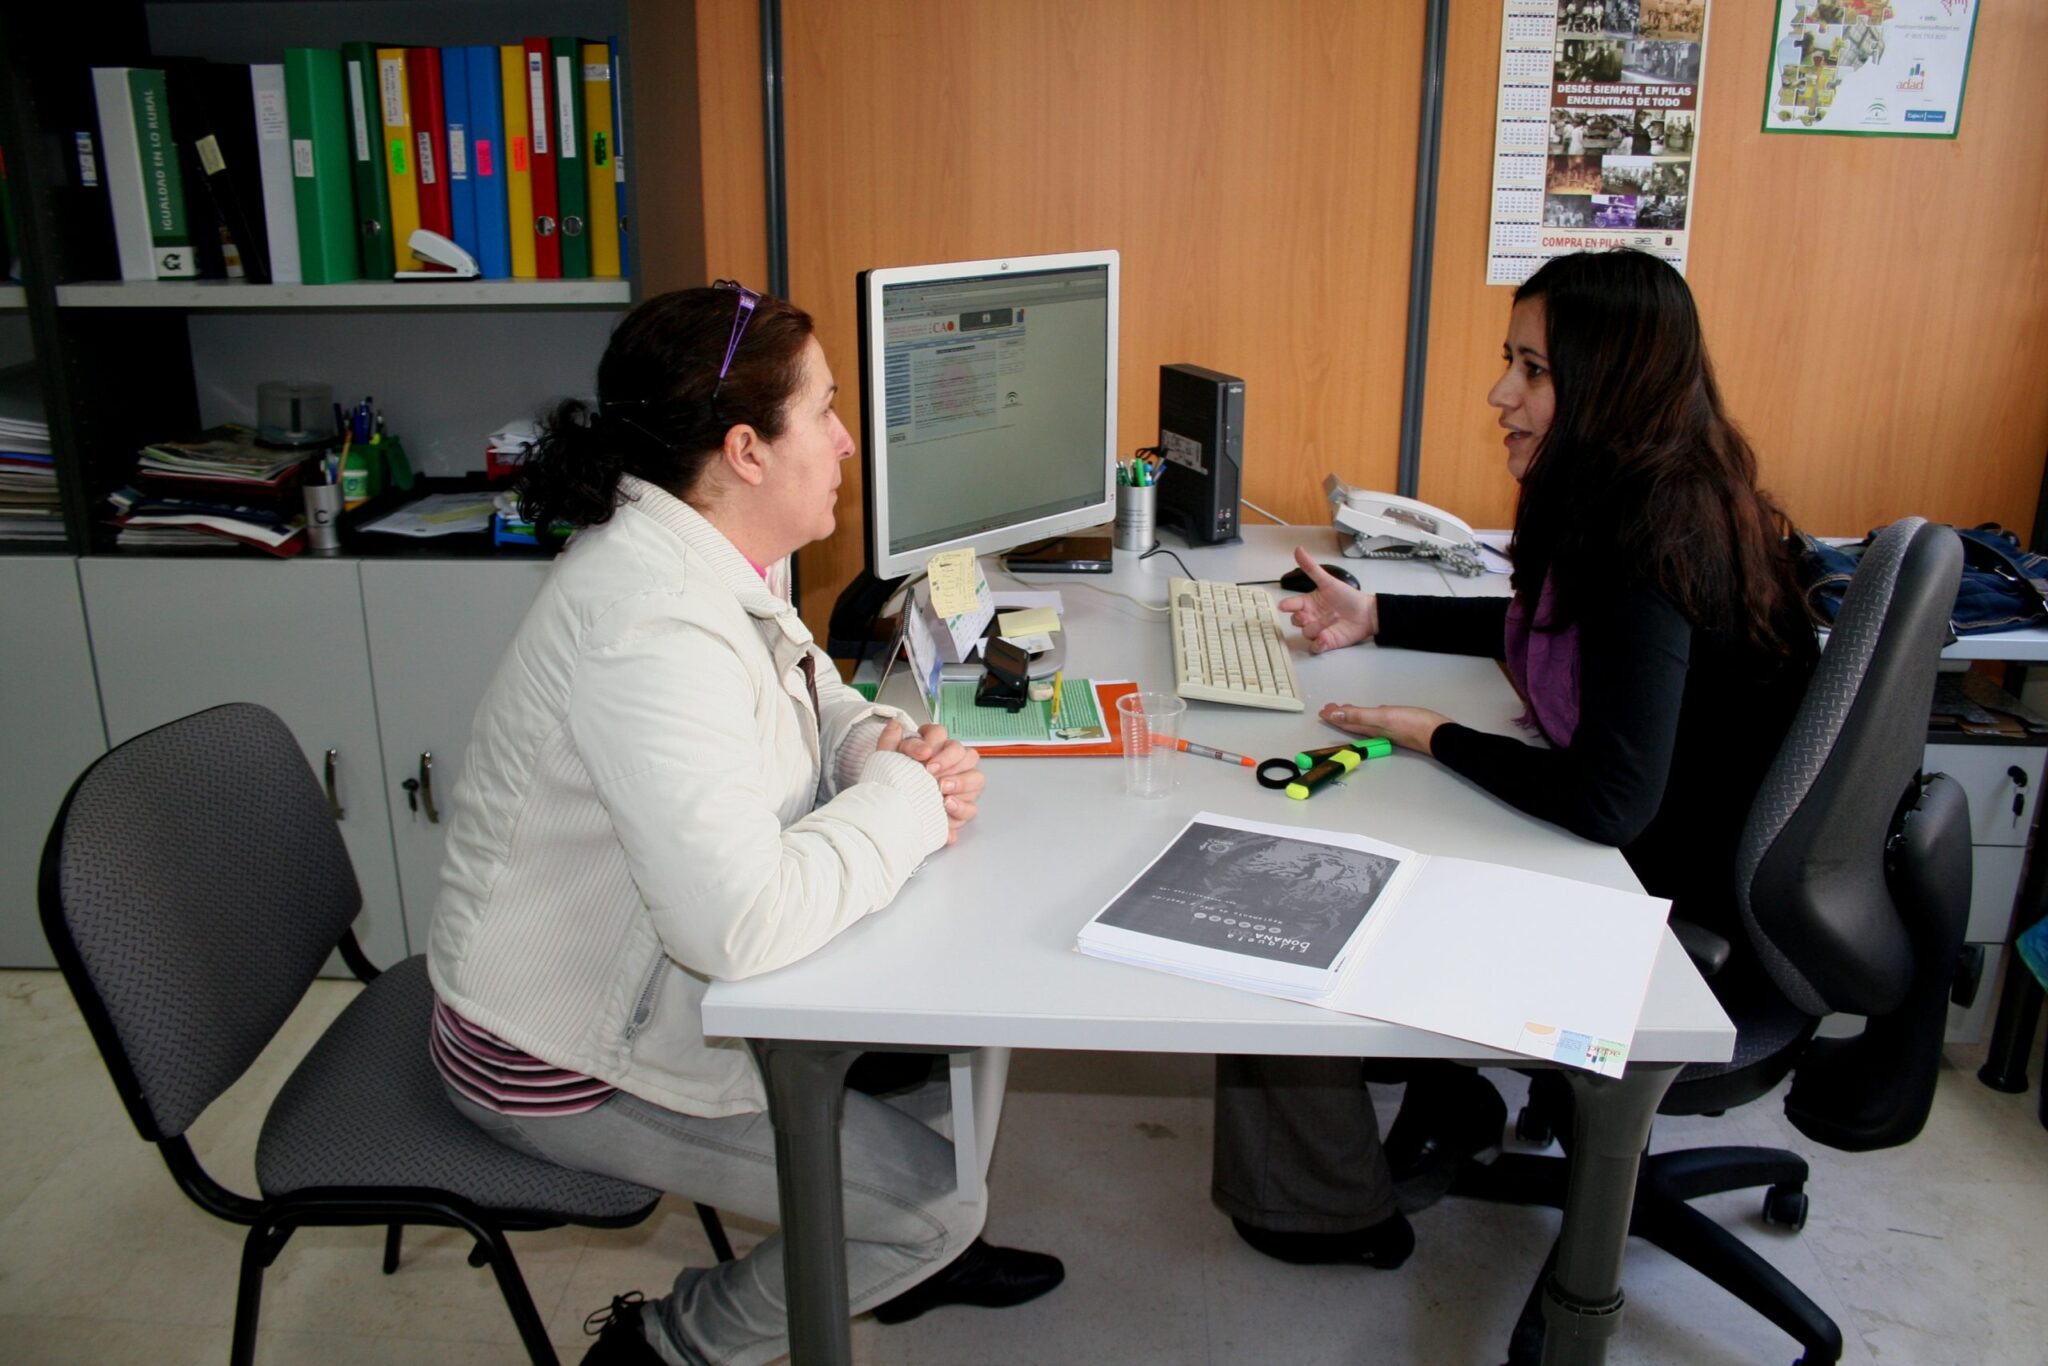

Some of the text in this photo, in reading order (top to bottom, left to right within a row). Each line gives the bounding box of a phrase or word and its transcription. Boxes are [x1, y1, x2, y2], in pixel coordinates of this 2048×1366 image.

[1557, 84, 1692, 96] DESDE SIEMPRE, EN PILAS
[1896, 79, 1924, 89] adad
[1567, 96, 1680, 107] ENCUENTRAS DE TODO
[144, 89, 173, 231] IGUALDAD EN LO RURAL
[1542, 237, 1626, 249] COMPRA EN PILAS
